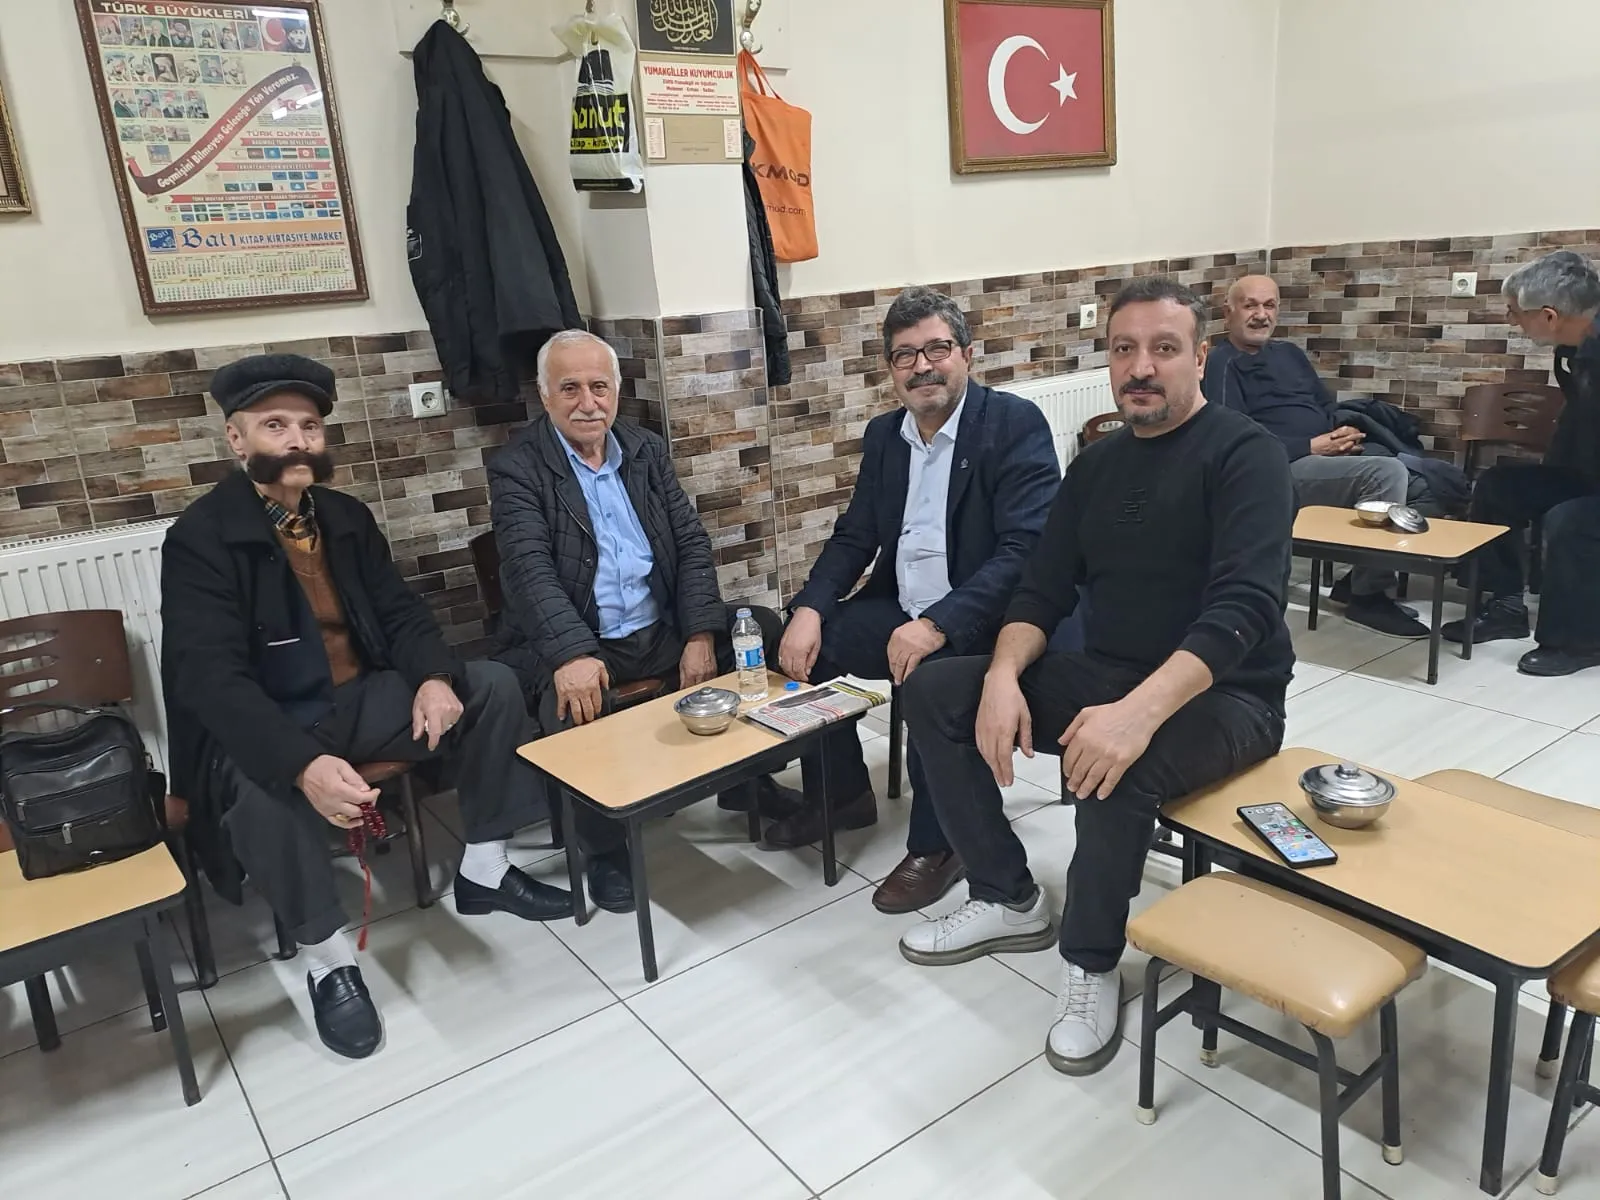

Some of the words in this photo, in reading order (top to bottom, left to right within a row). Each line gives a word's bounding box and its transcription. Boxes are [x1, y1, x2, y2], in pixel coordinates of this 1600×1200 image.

[101, 2, 148, 14] TÜRK
[154, 4, 249, 19] BÜYÜKLERİ
[690, 68, 734, 79] KUYUMCULUK
[192, 134, 224, 164] Bilmeyen
[310, 232, 343, 241] MARKET
